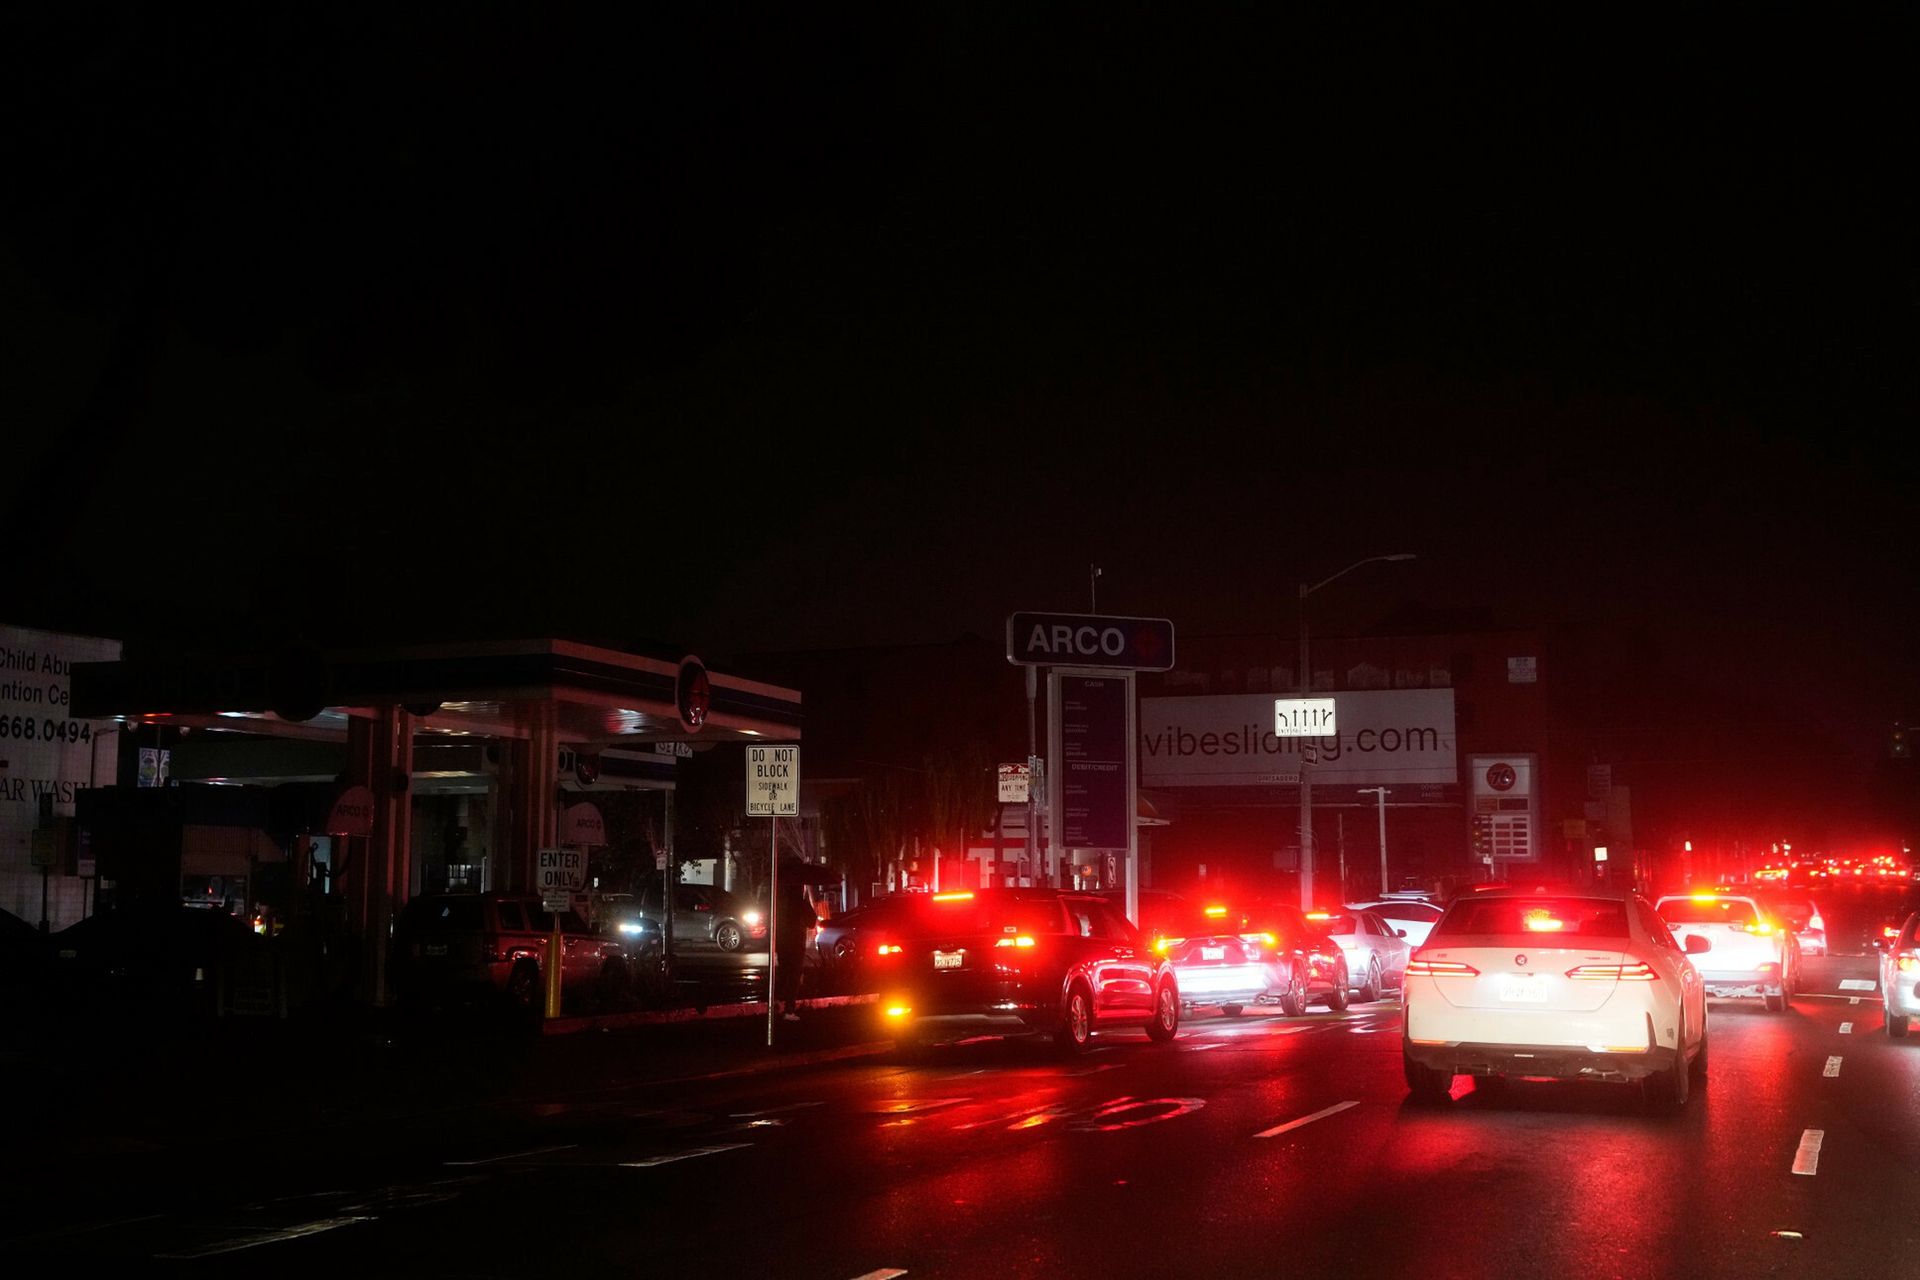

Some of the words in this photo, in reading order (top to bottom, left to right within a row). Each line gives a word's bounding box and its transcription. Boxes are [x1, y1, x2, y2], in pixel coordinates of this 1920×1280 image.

[1026, 623, 1125, 656] ARCO
[1084, 680, 1104, 688] CASH
[0, 714, 91, 744] 668.0494
[752, 749, 765, 762] DO
[774, 749, 793, 762] NOT
[757, 764, 789, 777] BLOCK
[758, 782, 788, 791] SIDEWALK
[769, 792, 777, 801] OR
[750, 803, 775, 811] BICYCLE
[780, 803, 795, 811] LANE
[540, 852, 579, 868] ENTER
[545, 871, 575, 887] ONLY
